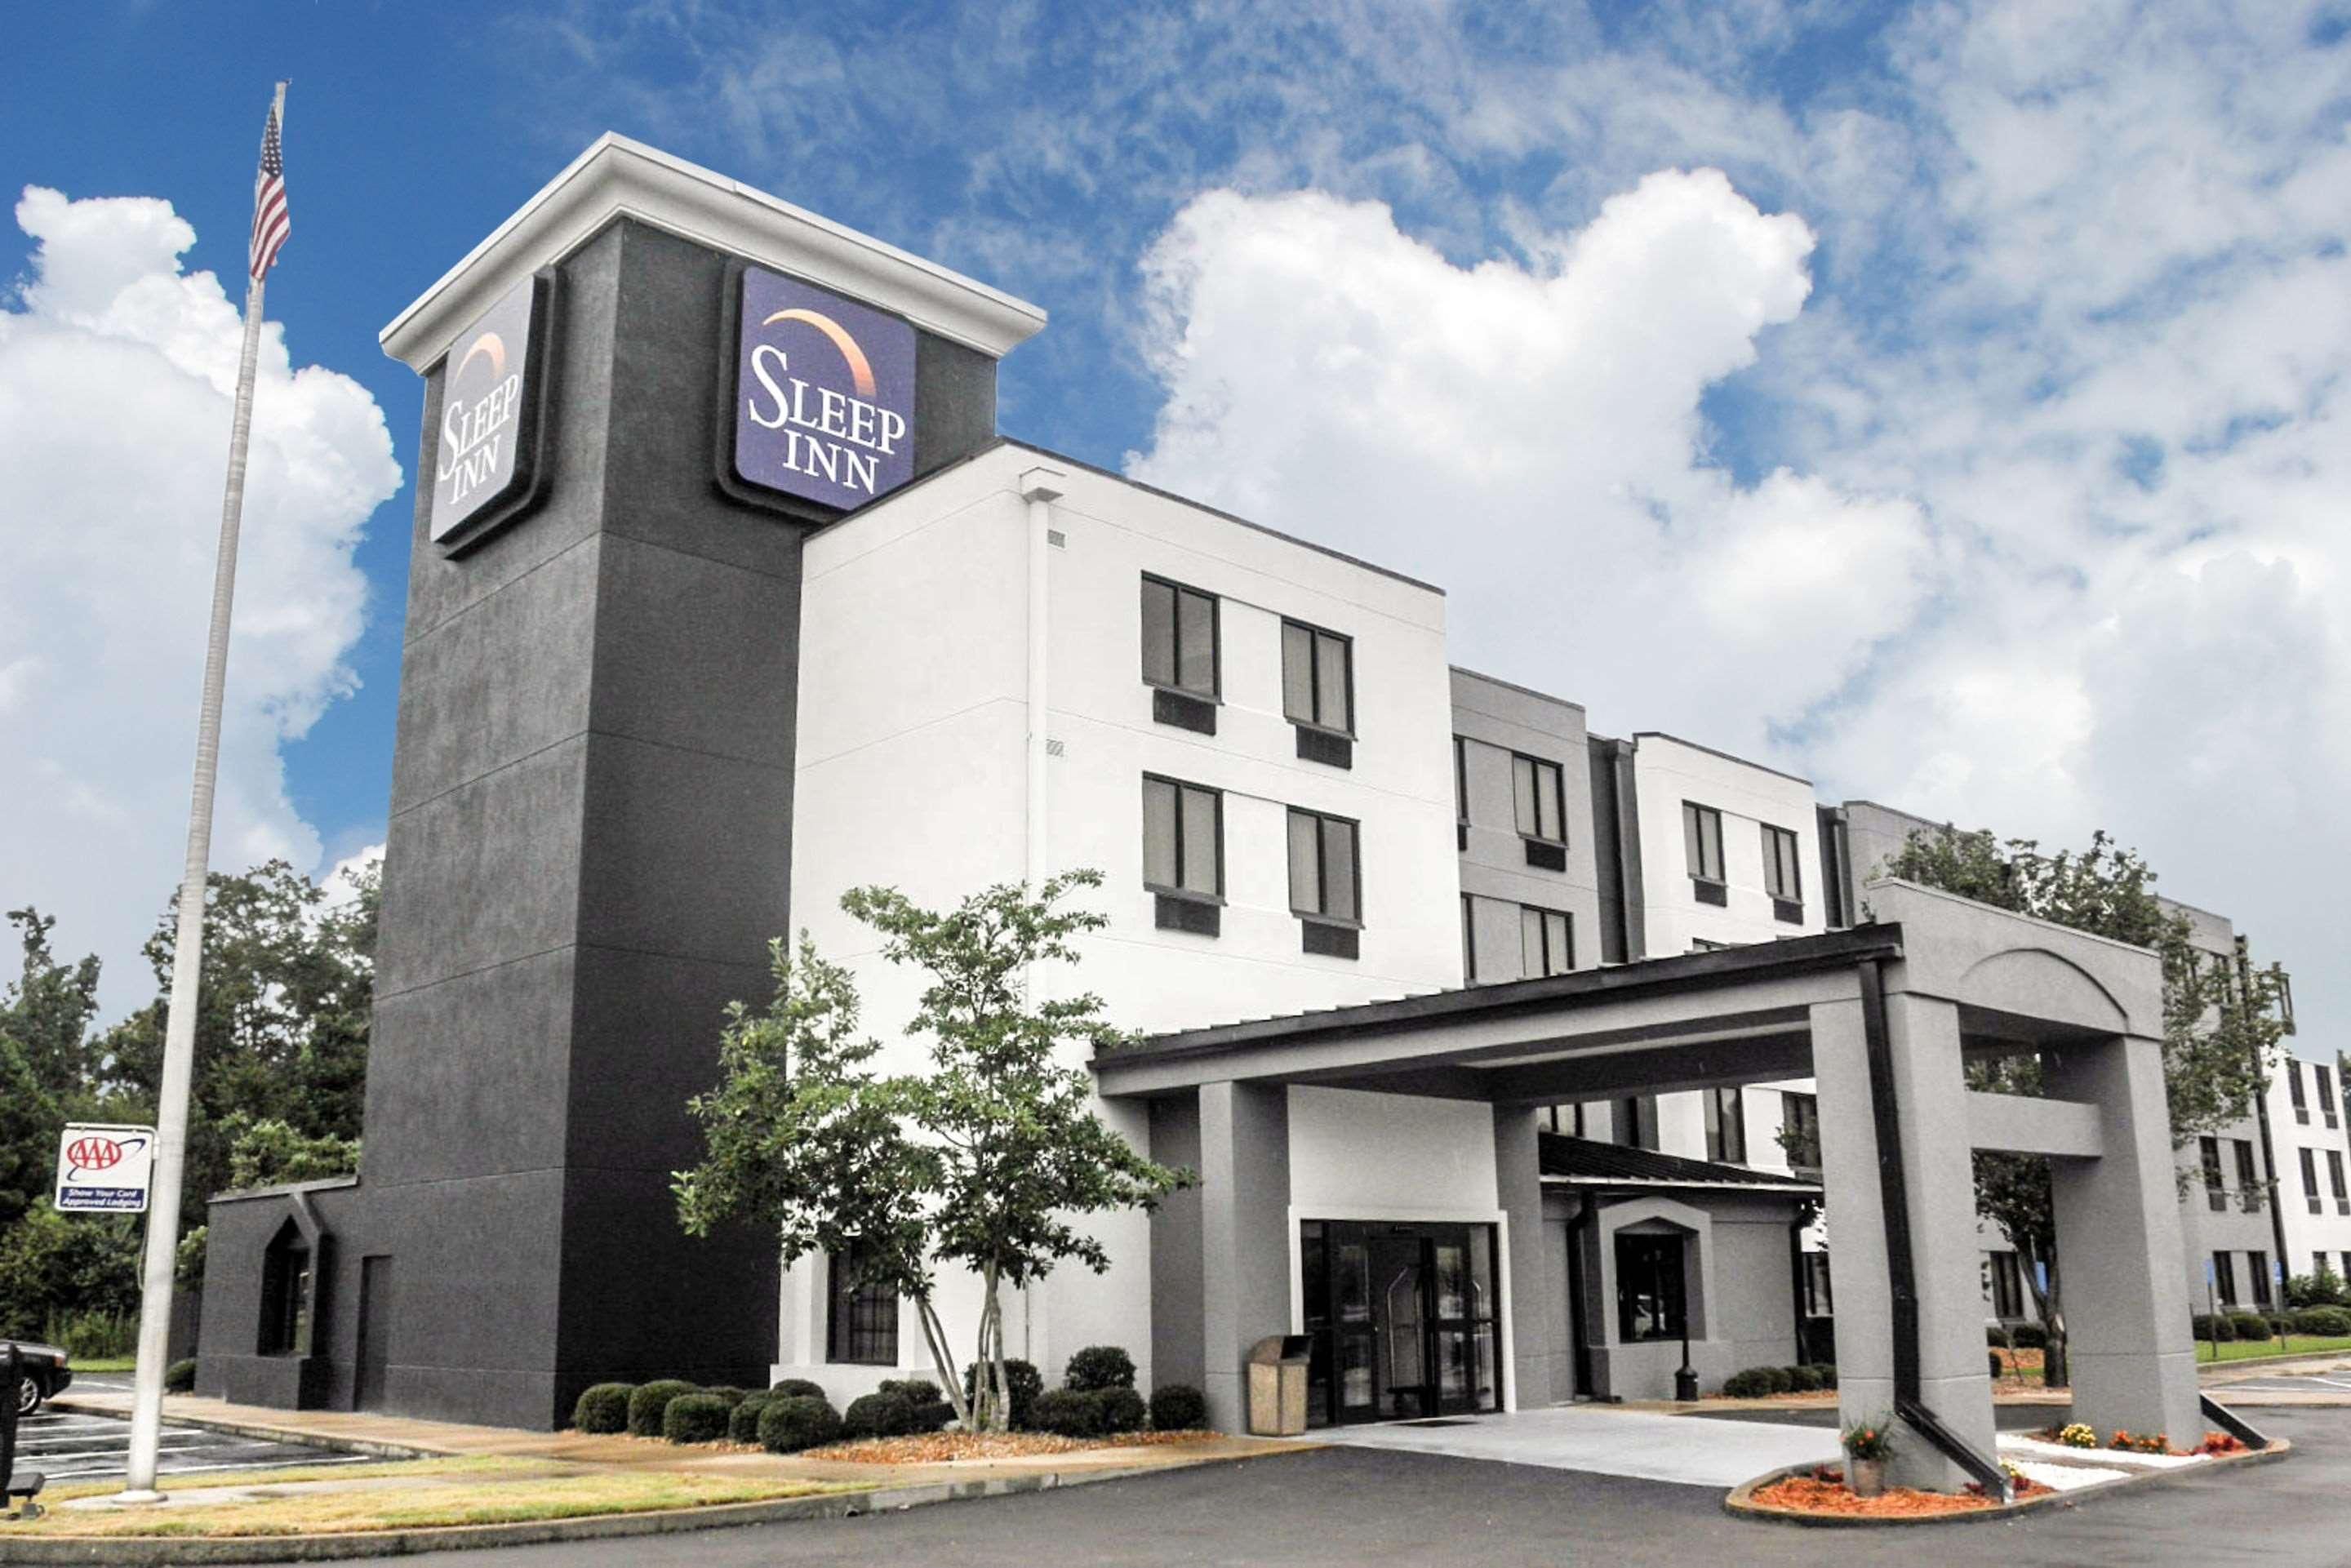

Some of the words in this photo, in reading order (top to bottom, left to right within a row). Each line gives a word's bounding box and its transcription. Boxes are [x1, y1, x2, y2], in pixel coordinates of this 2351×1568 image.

[439, 374, 518, 482] SLEEP
[749, 344, 905, 455] SLEEP
[450, 434, 501, 504] INN
[783, 429, 879, 495] INN
[73, 1137, 115, 1170] AAA
